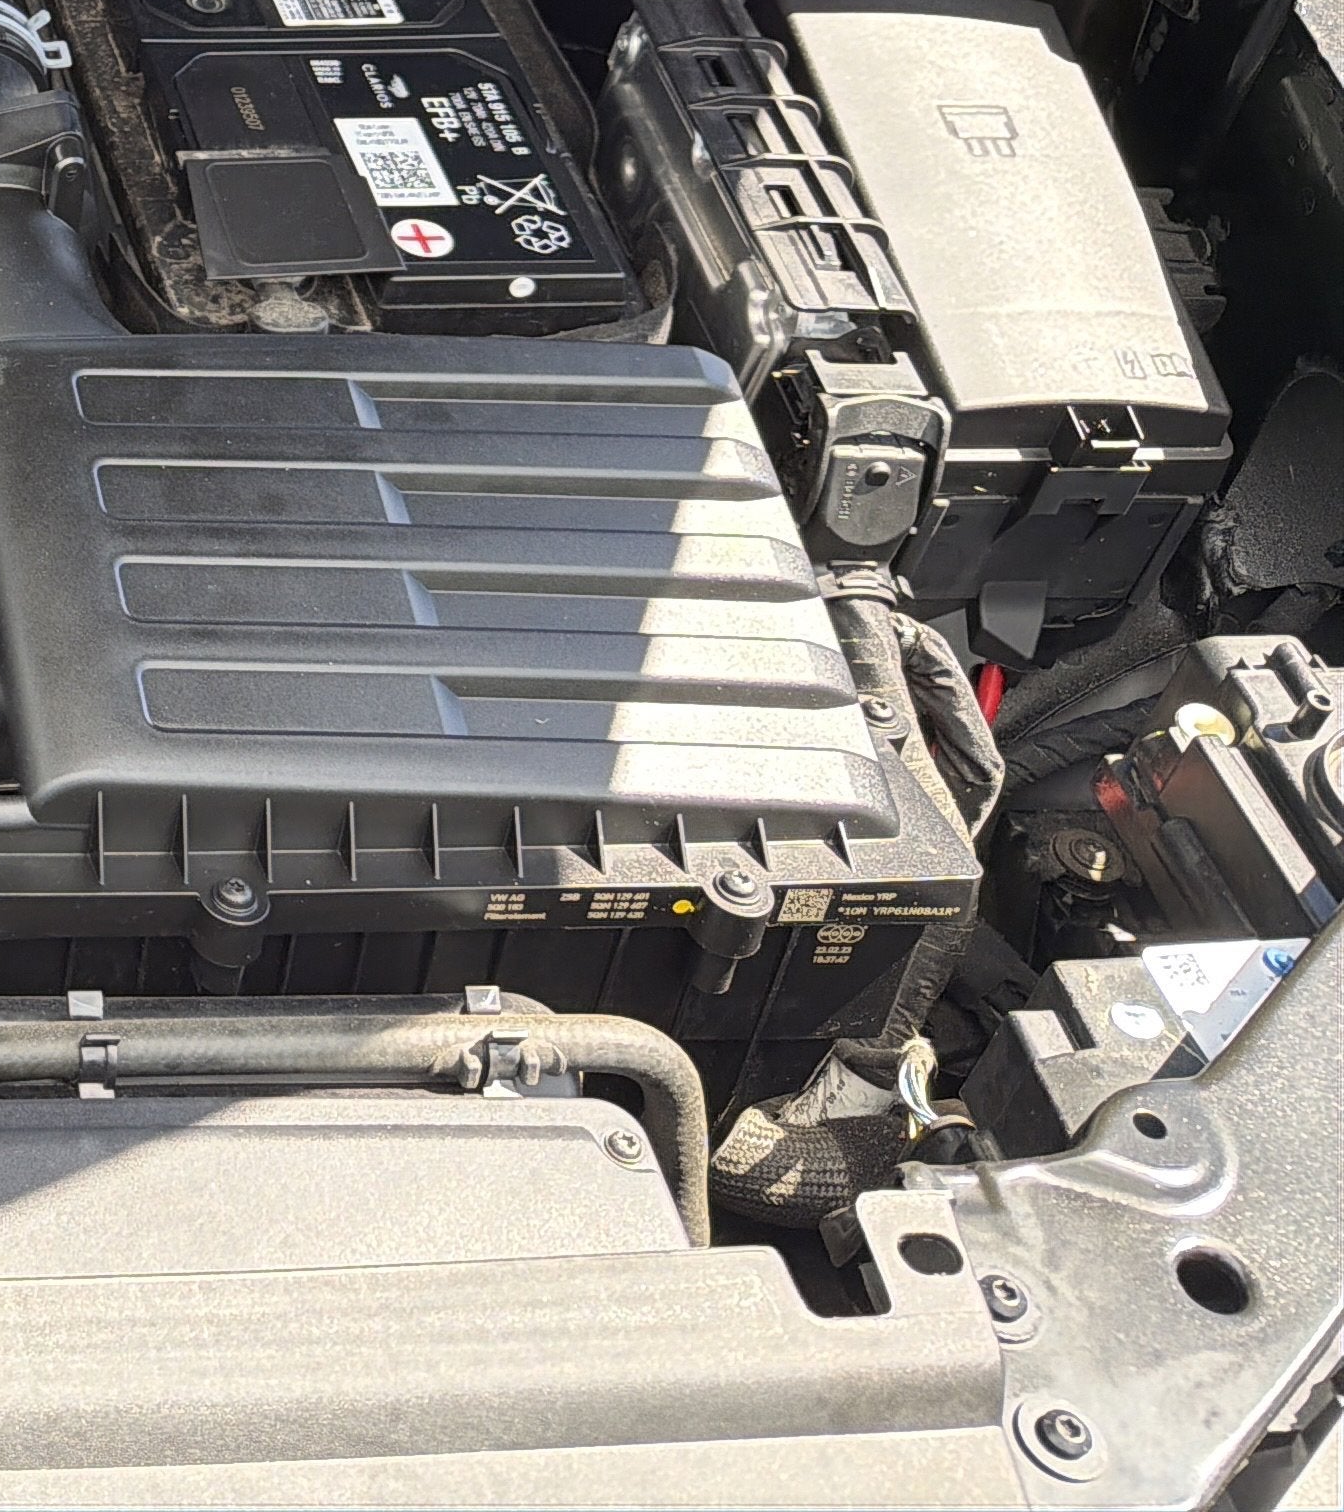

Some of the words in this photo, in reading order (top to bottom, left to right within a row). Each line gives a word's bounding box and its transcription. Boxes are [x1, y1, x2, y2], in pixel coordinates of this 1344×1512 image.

[361, 63, 394, 109] CLARIOS
[420, 96, 462, 143] EFB+
[488, 102, 512, 121] 915
[500, 124, 524, 143] 105
[511, 146, 532, 155] B
[456, 185, 479, 205] Pb
[490, 893, 509, 902] VW
[508, 893, 526, 902] AG
[841, 893, 875, 901] Mexico
[876, 892, 898, 901] YRP
